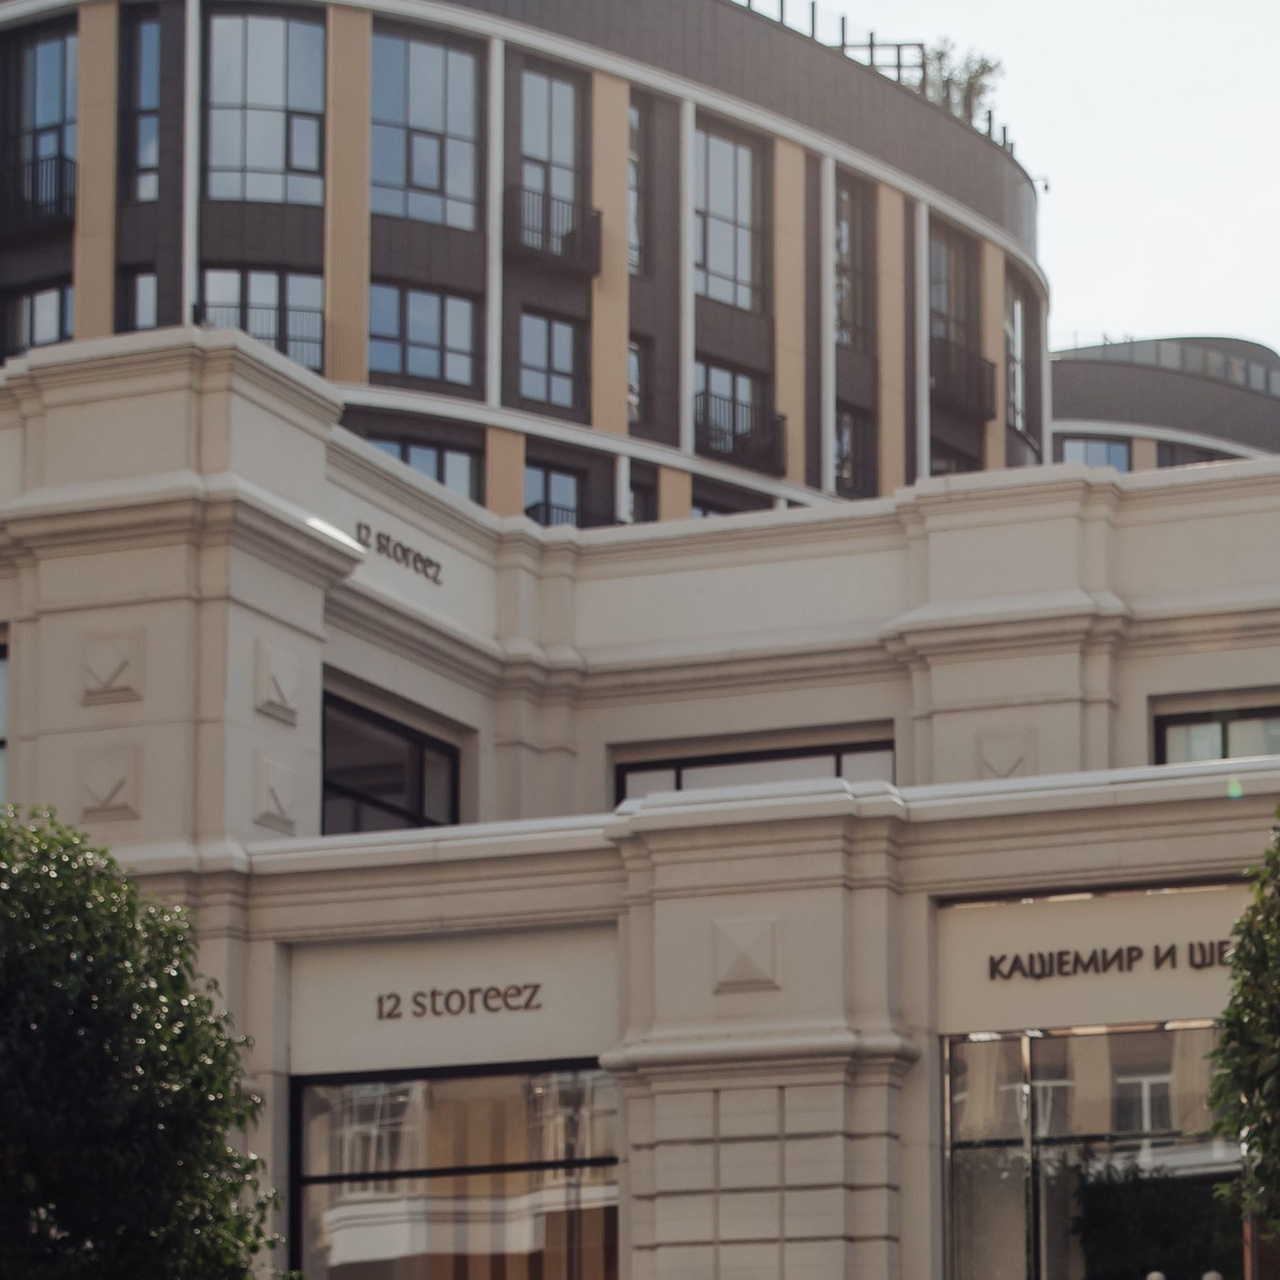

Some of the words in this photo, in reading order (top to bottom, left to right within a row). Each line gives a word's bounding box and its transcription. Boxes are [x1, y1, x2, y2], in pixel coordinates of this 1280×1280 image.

[376, 532, 442, 585] storeez
[988, 945, 1143, 981] КАШЕМИР
[1154, 943, 1176, 970] И
[1188, 939, 1240, 970] ШЕ
[376, 993, 402, 1020] 12
[411, 983, 542, 1018] storeez
